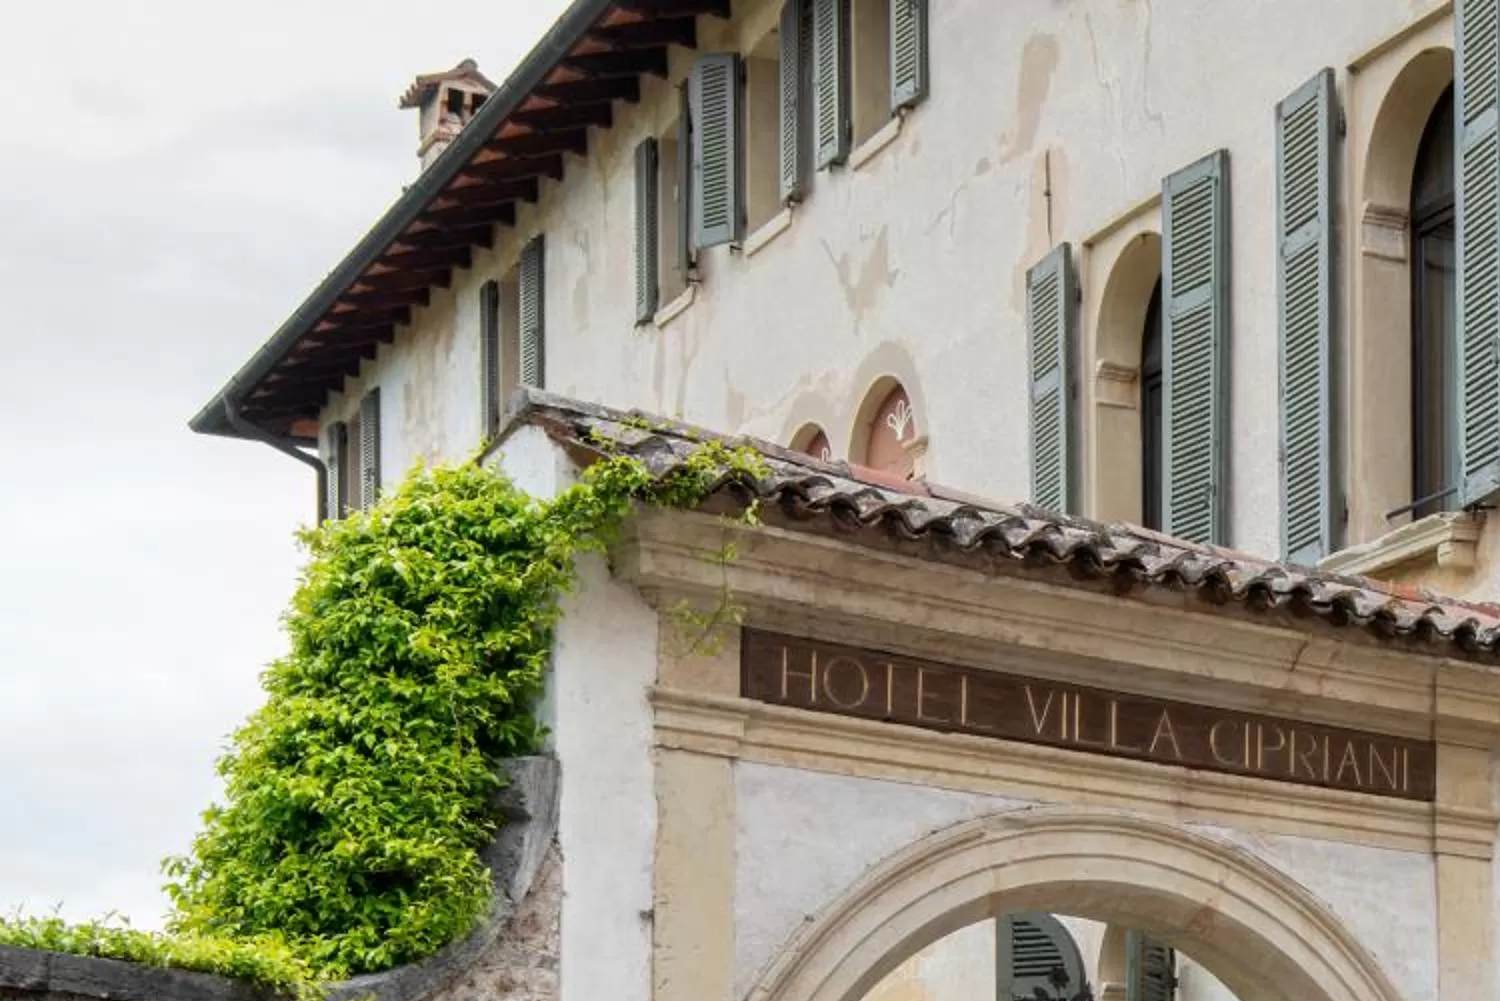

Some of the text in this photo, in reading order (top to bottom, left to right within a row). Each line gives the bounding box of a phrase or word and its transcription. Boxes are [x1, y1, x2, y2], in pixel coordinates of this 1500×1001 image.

[780, 646, 1408, 791] HOTEL VILLA CIPRIANI
